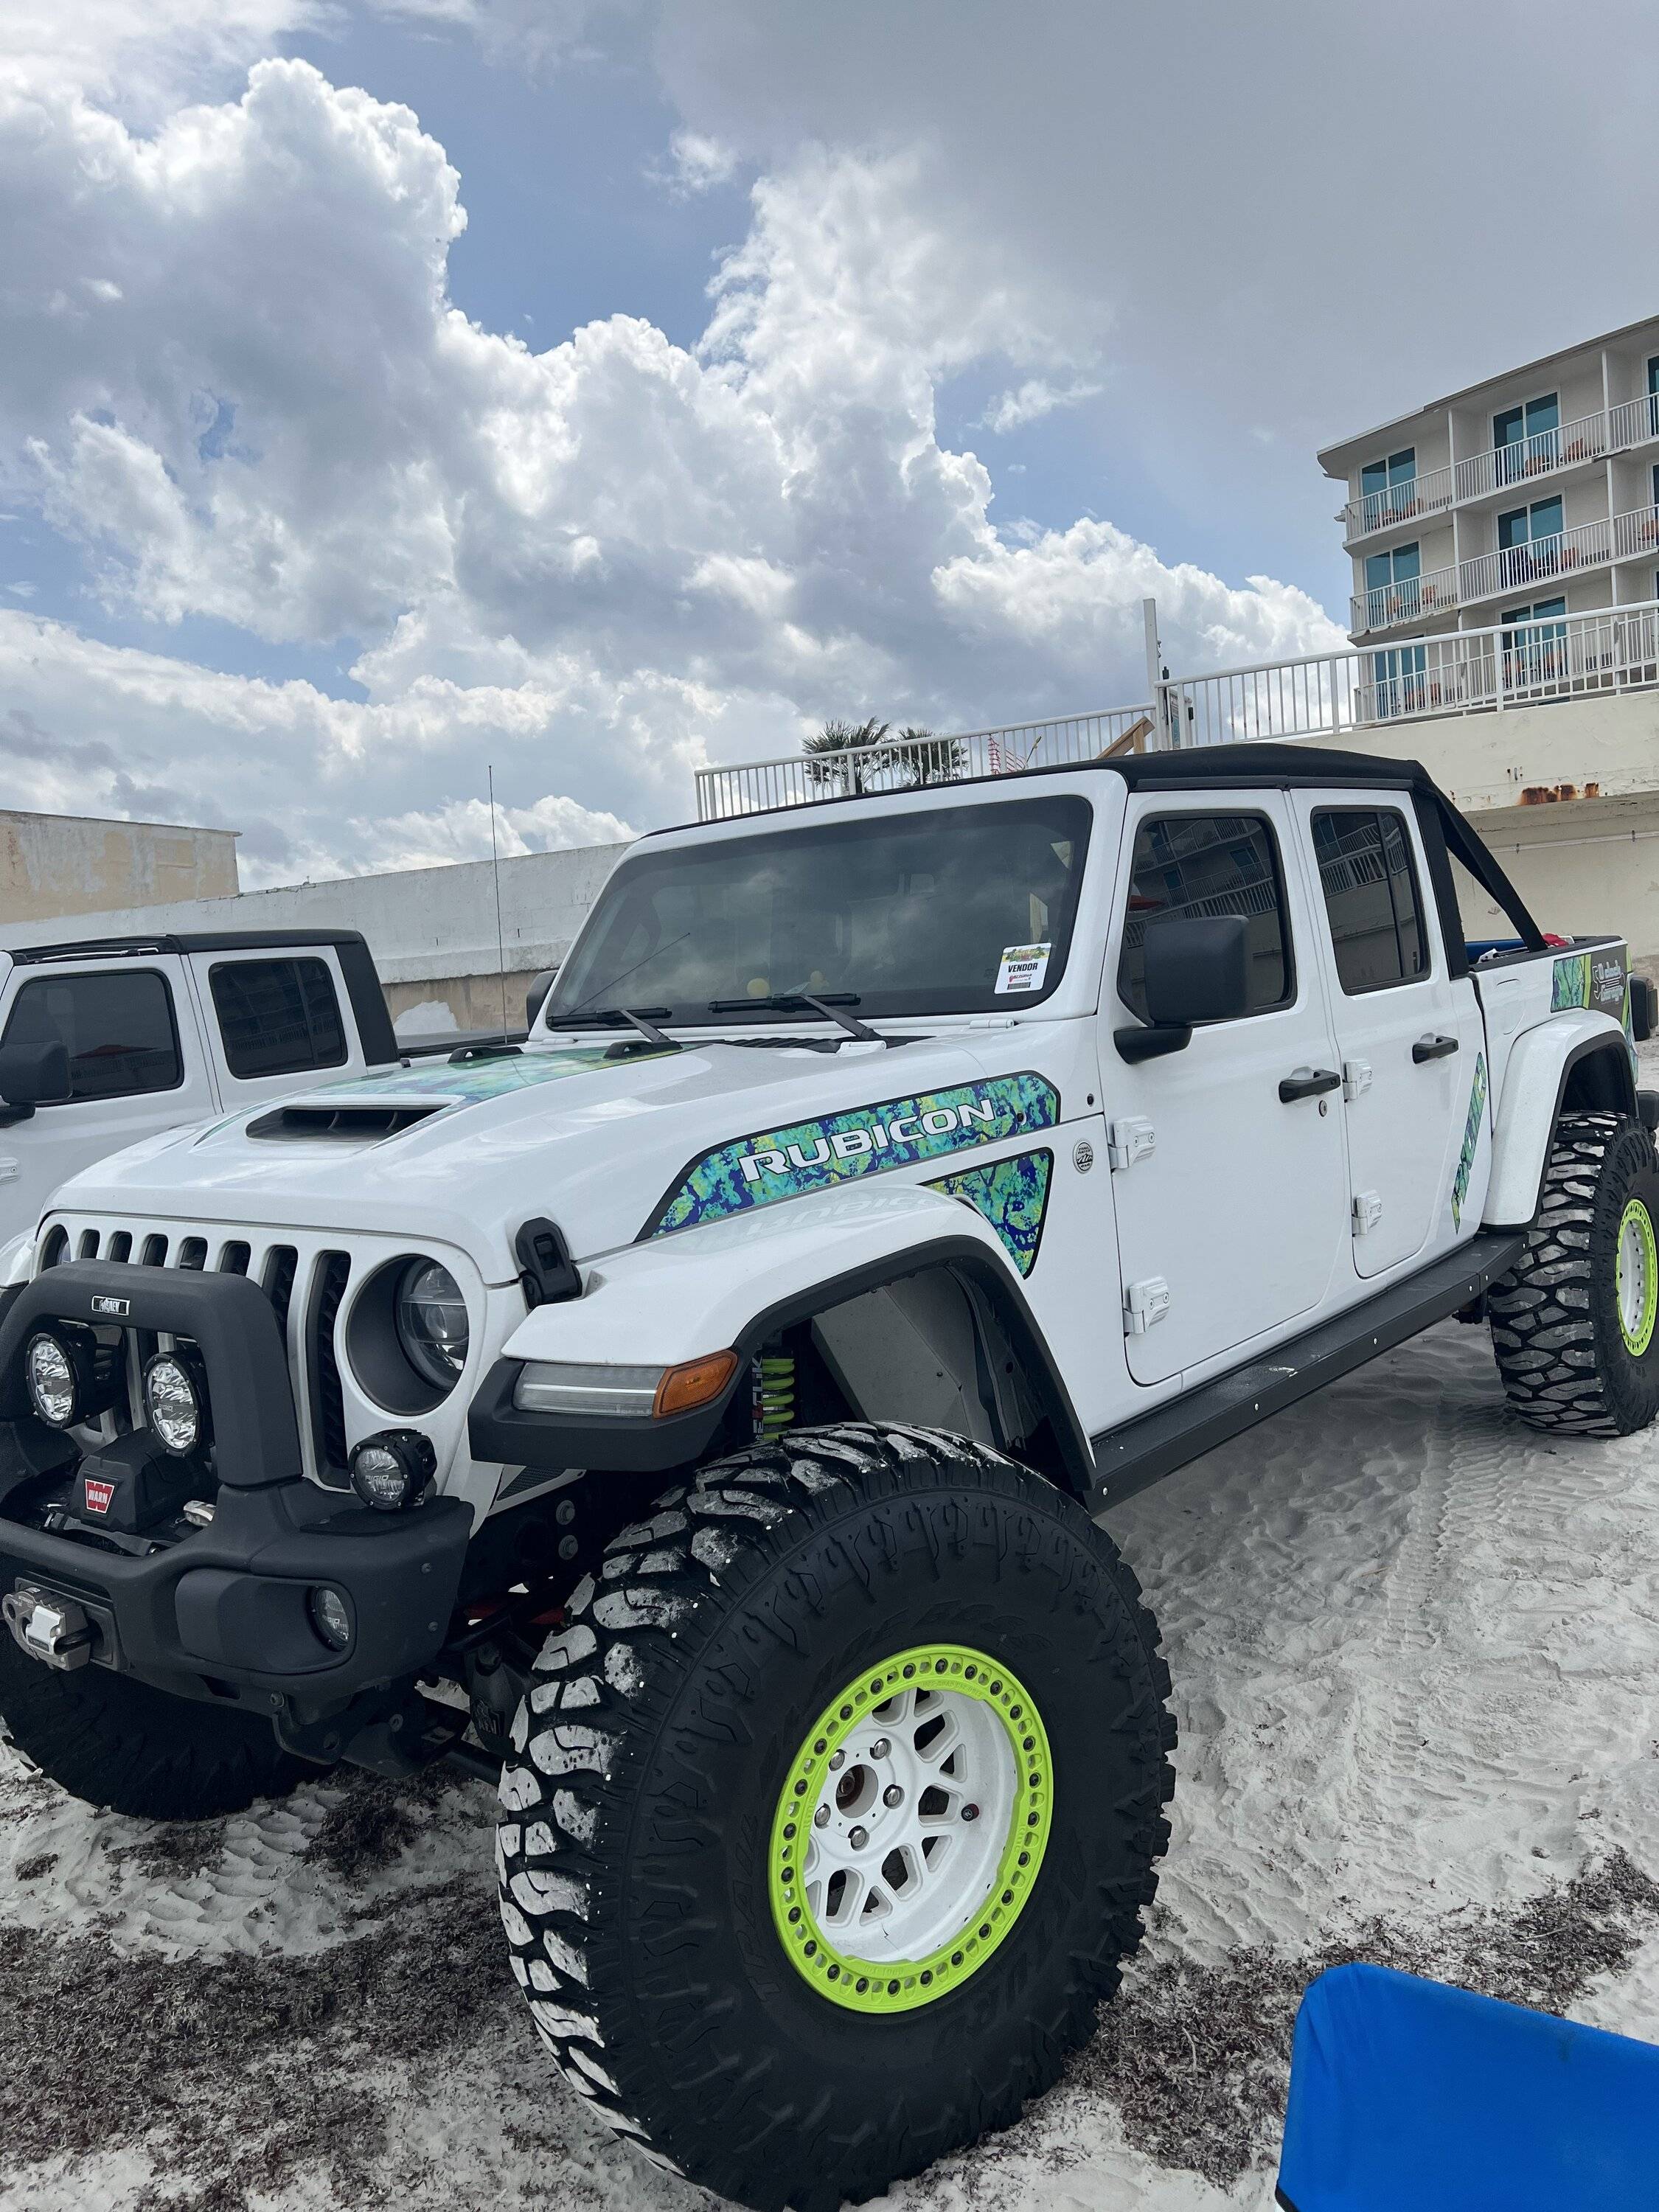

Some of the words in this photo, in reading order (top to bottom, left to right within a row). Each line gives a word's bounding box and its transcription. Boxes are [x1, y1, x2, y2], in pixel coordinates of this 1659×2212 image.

[1008, 962, 1038, 973] VENDOR
[737, 1099, 995, 1183] RUBICON
[88, 1489, 108, 1504] WARN
